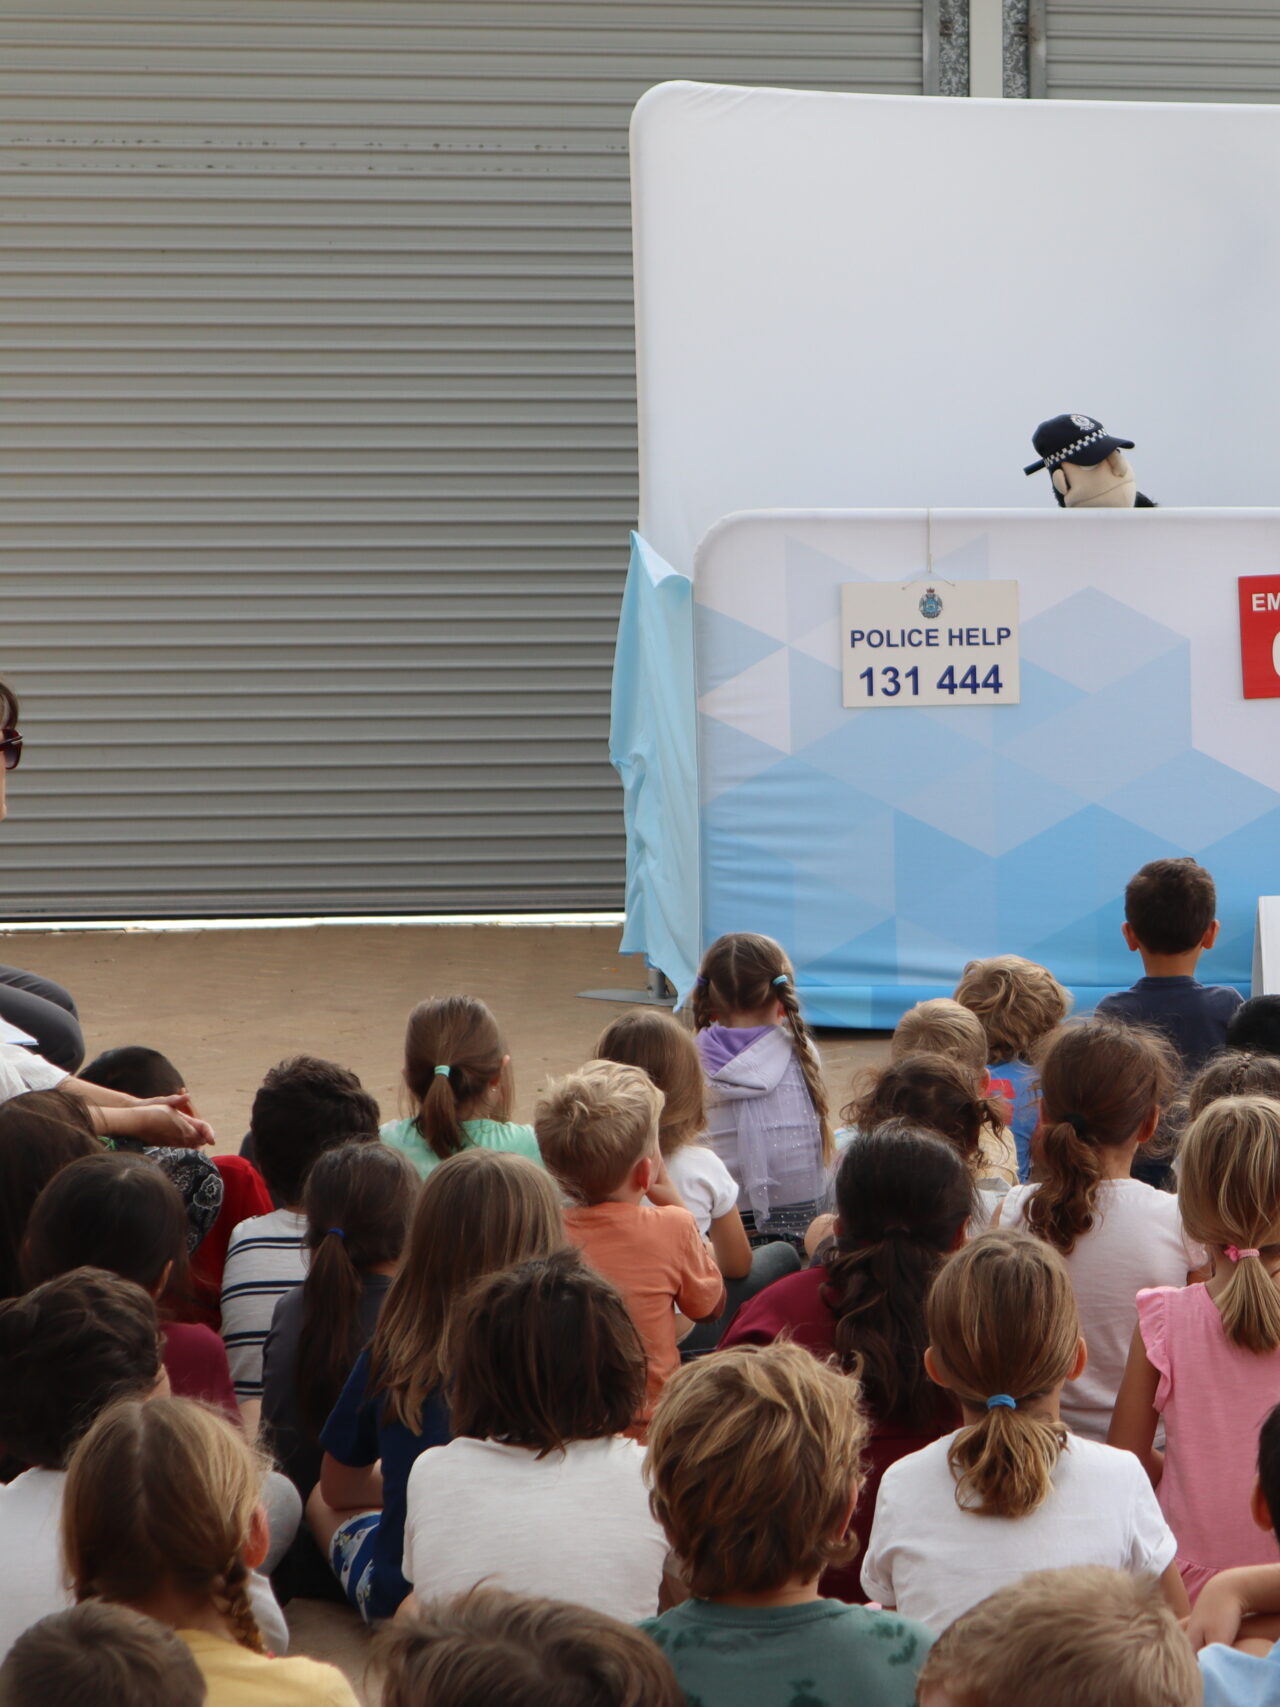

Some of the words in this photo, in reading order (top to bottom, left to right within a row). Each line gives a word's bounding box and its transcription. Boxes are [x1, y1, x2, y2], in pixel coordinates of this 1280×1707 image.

[850, 628, 939, 648] POLICE
[948, 627, 1011, 646] HELP
[859, 666, 919, 697] 131
[936, 664, 1003, 695] 444
